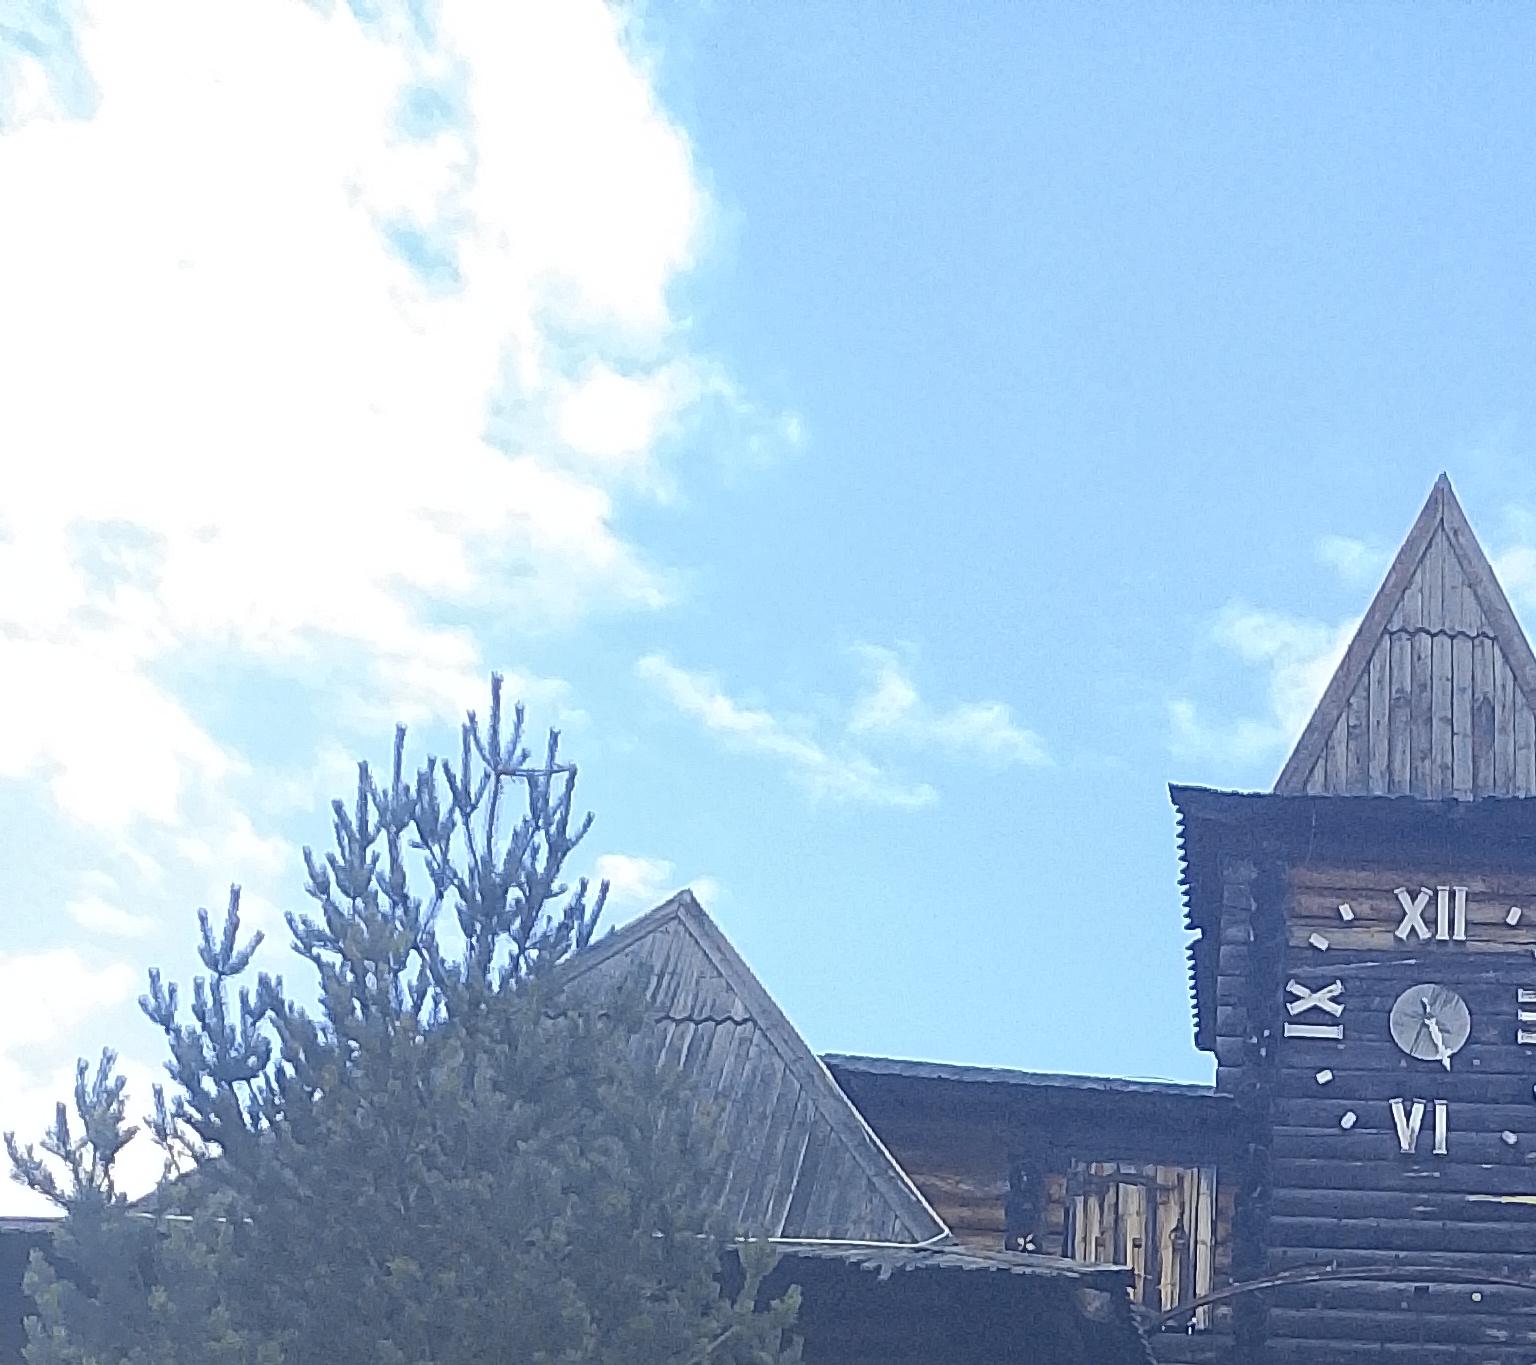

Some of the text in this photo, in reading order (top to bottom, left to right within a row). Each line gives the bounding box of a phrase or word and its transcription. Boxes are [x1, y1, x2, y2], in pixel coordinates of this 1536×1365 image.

[1393, 885, 1469, 941] XII
[1283, 978, 1345, 1040] IX
[1389, 1098, 1448, 1155] VI
